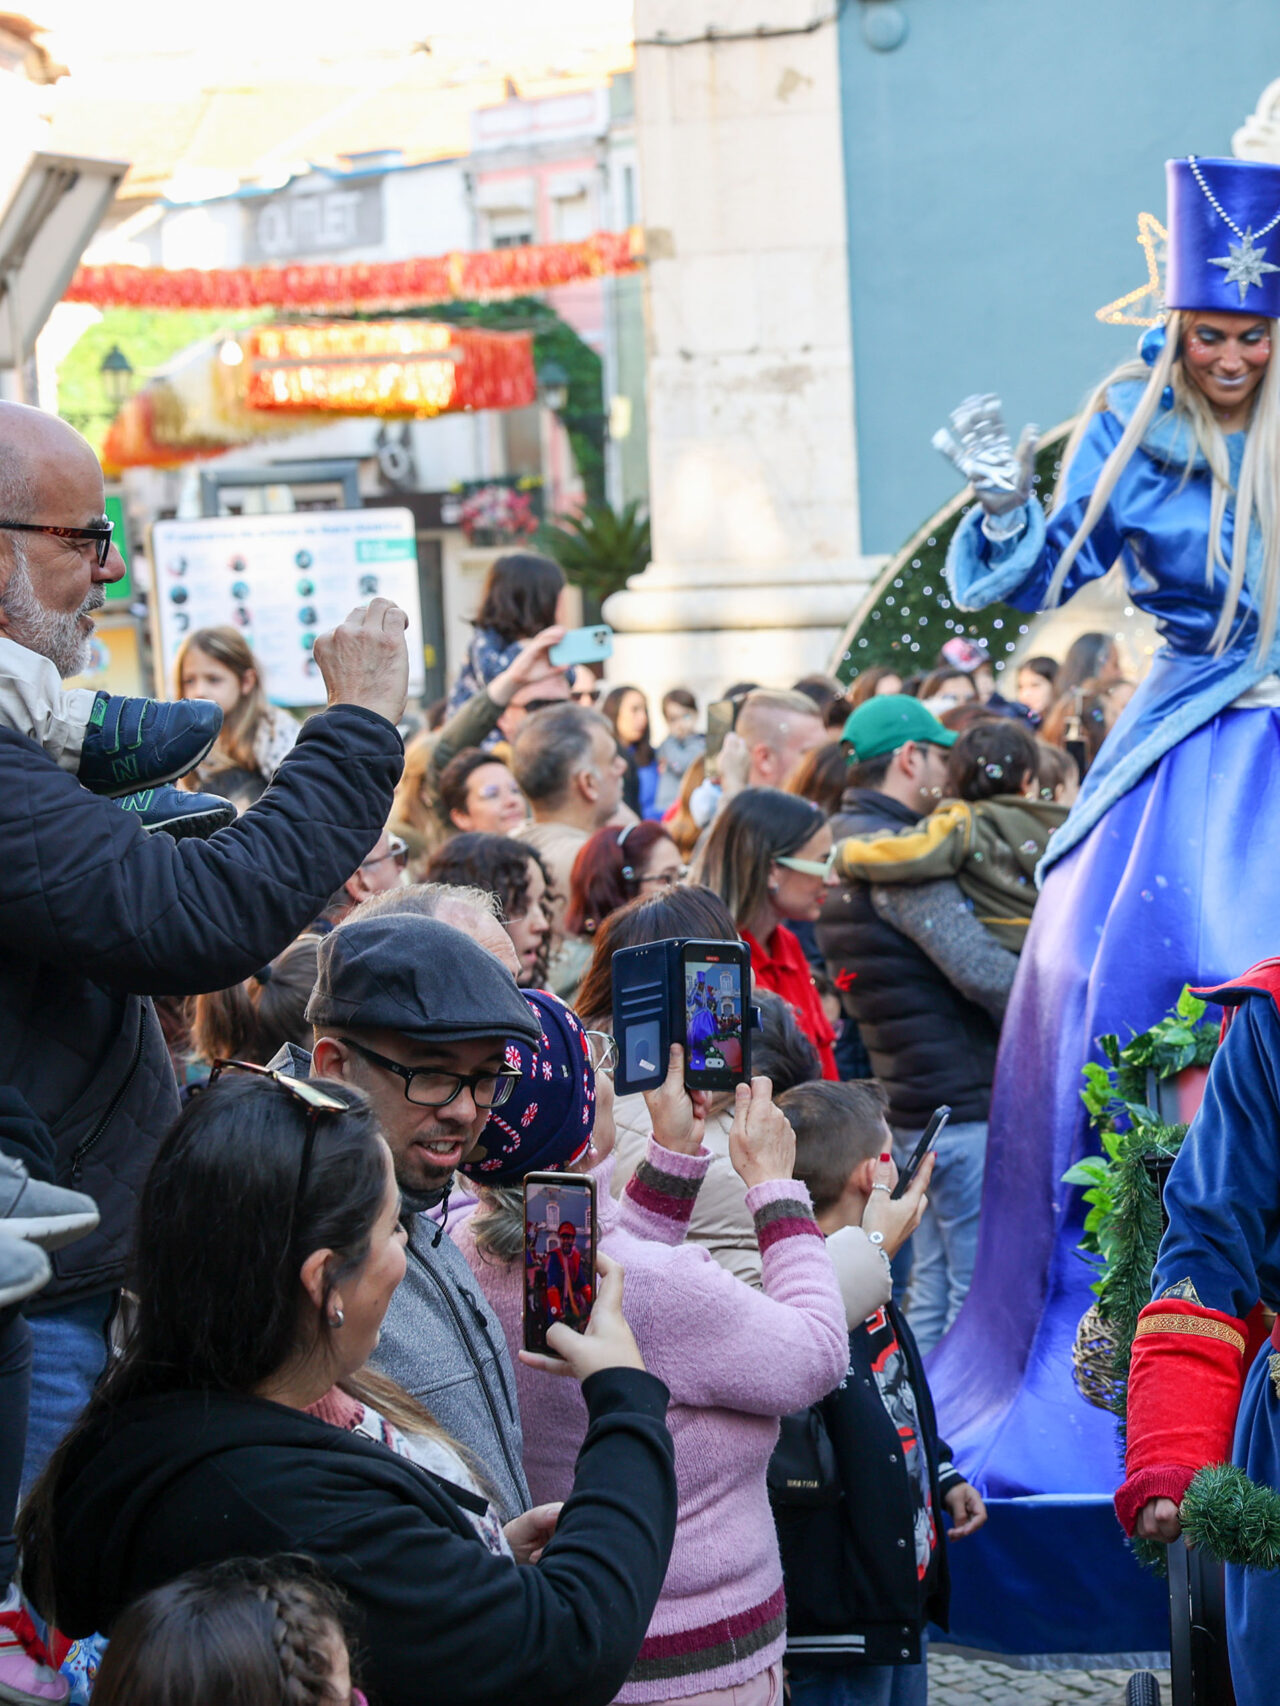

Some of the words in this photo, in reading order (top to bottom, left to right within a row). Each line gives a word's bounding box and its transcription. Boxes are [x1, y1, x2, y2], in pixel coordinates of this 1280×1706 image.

[257, 191, 362, 255] OUTLET
[112, 754, 140, 782] N
[121, 789, 154, 812] N
